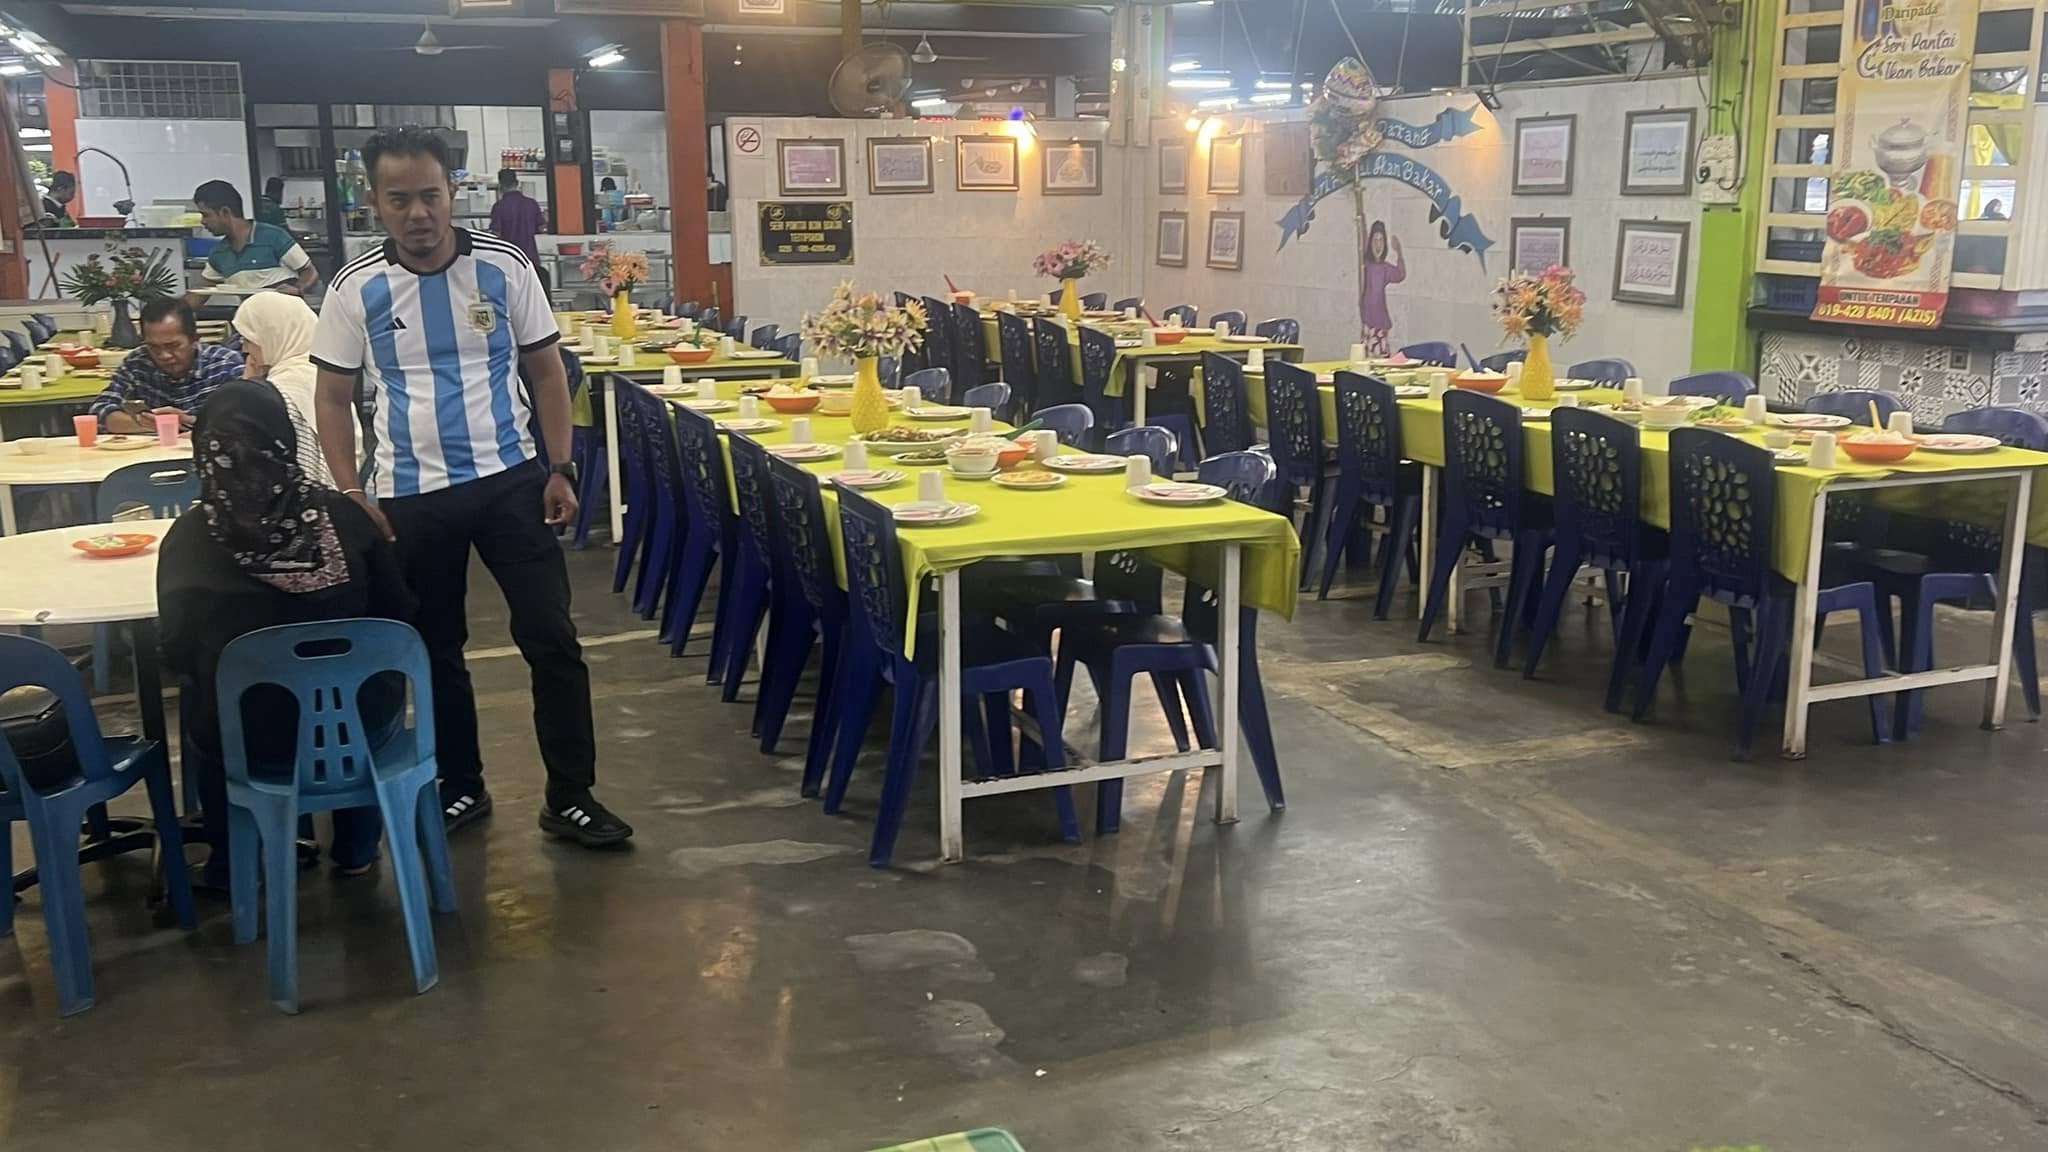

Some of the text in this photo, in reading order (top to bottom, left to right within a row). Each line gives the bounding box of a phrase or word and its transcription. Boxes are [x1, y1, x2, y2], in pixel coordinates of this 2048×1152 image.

[1885, 5, 1938, 20] Daripada
[1882, 30, 1956, 53] Seri Pantai
[1884, 55, 1961, 79] Ikan Bakar
